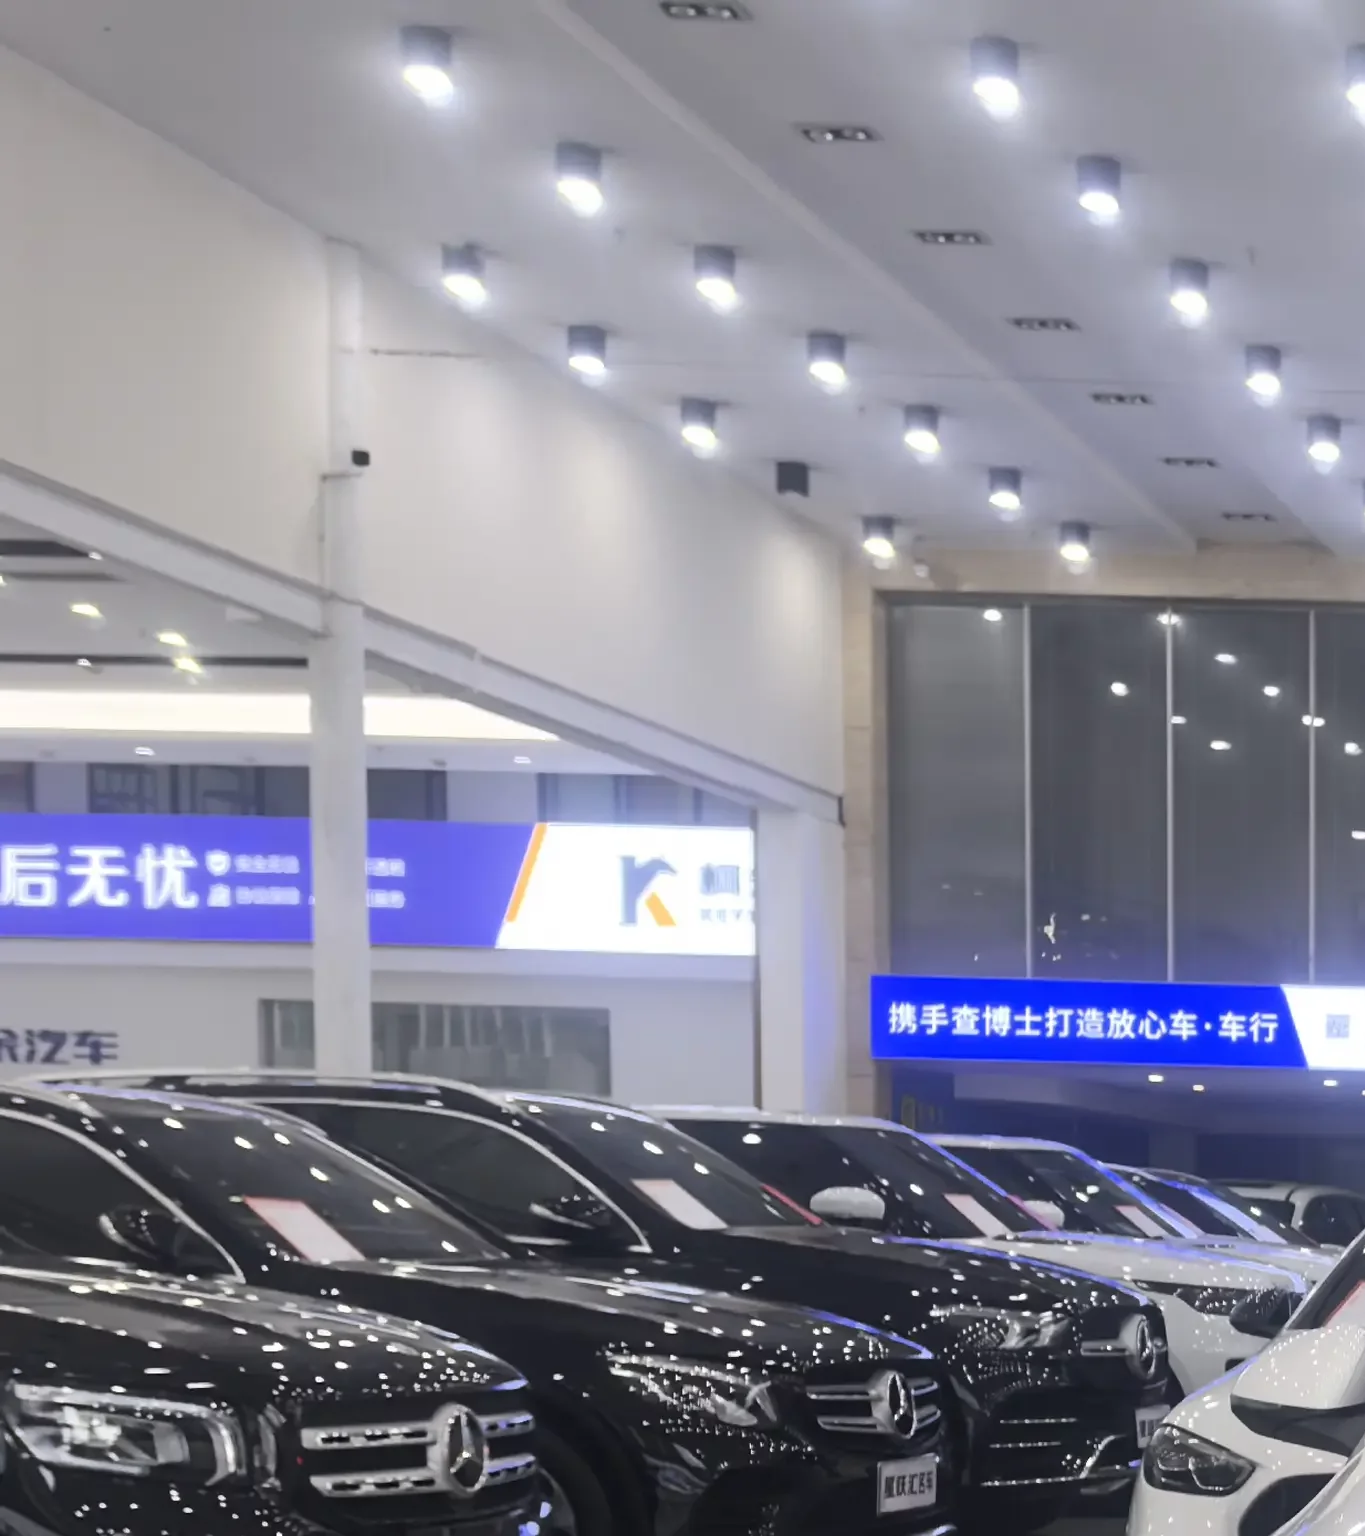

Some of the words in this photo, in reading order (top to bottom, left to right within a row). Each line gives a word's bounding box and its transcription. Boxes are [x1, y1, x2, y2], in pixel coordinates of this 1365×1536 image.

[1, 844, 198, 909] 后无忧
[887, 1002, 1279, 1045] 携手查博士打造放心车·车行
